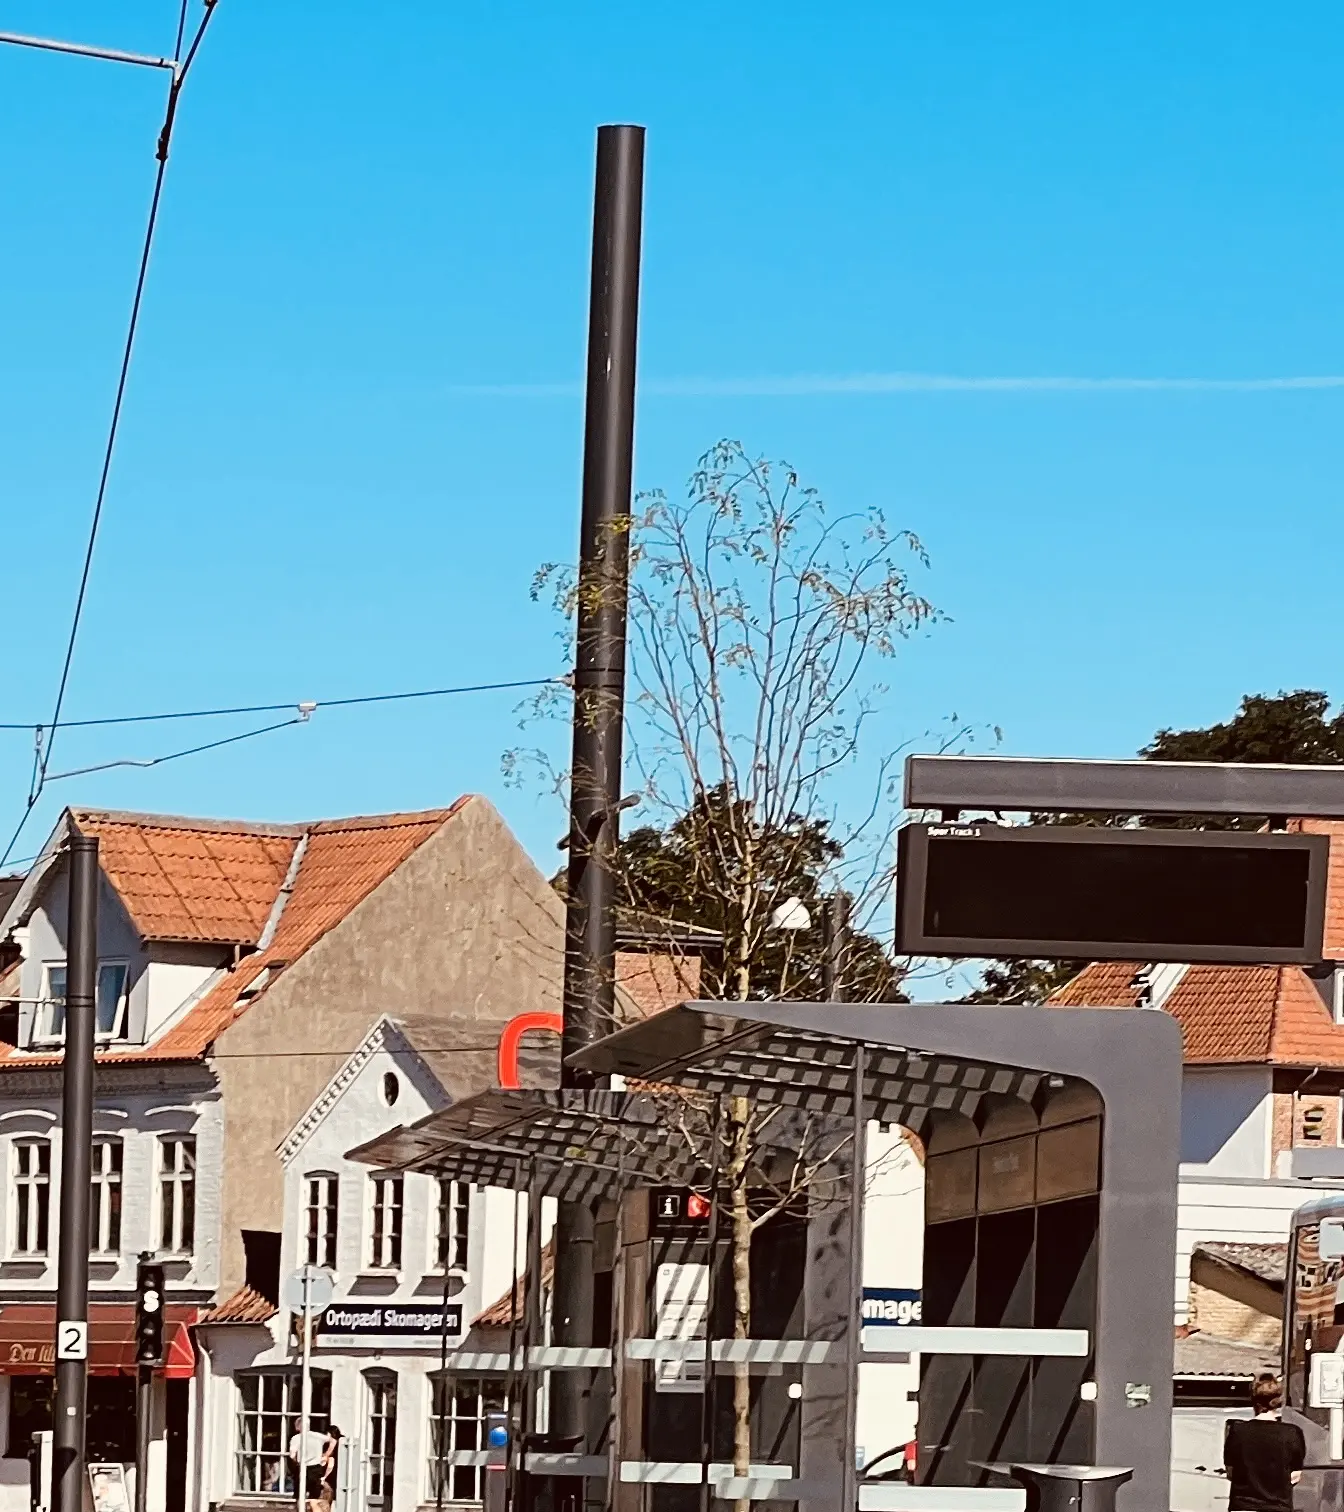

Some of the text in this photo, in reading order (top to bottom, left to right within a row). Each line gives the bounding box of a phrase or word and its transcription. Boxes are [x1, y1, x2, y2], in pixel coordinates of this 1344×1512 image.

[326, 1309, 382, 1330] Ortopædi
[862, 1299, 922, 1325] mage
[64, 1327, 82, 1353] 2
[9, 1343, 37, 1362] Den
